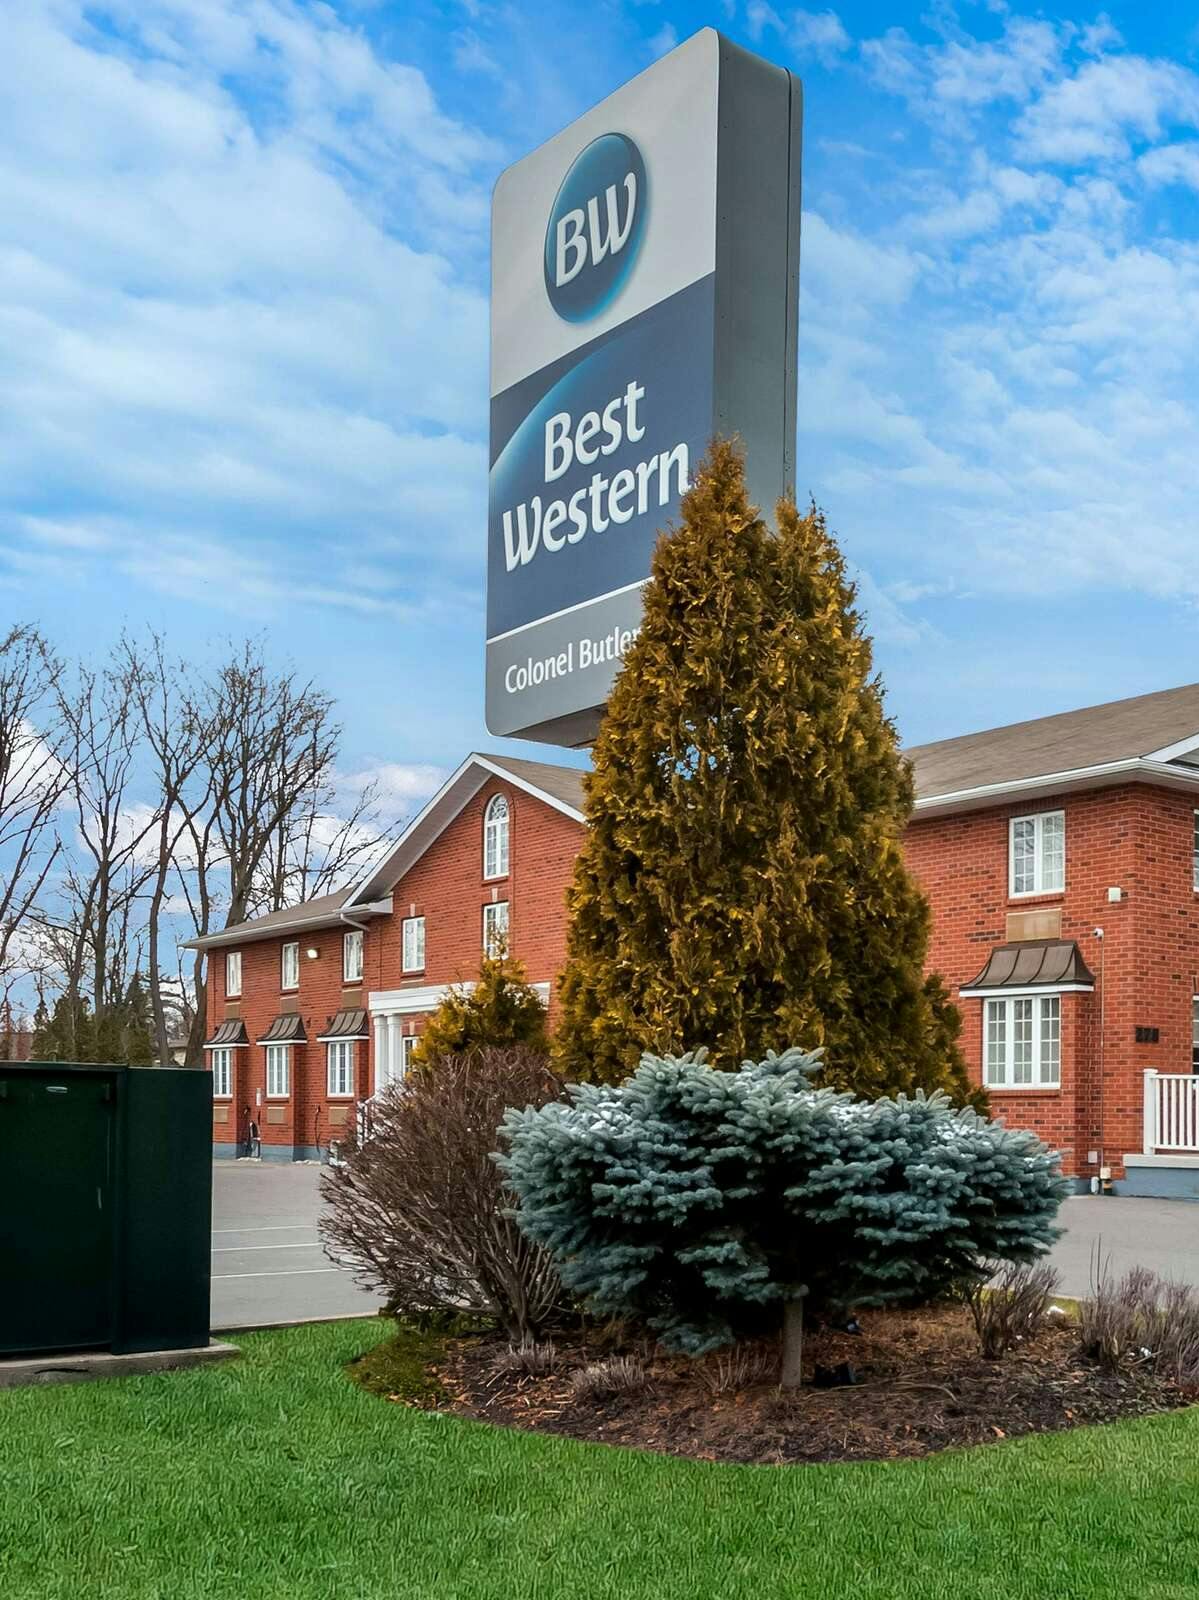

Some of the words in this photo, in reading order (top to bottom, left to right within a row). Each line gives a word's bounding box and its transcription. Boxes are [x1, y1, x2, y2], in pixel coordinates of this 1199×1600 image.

[555, 172, 637, 287] BW
[545, 380, 646, 483] Best
[502, 443, 692, 572] Western
[505, 643, 573, 694] Colonel
